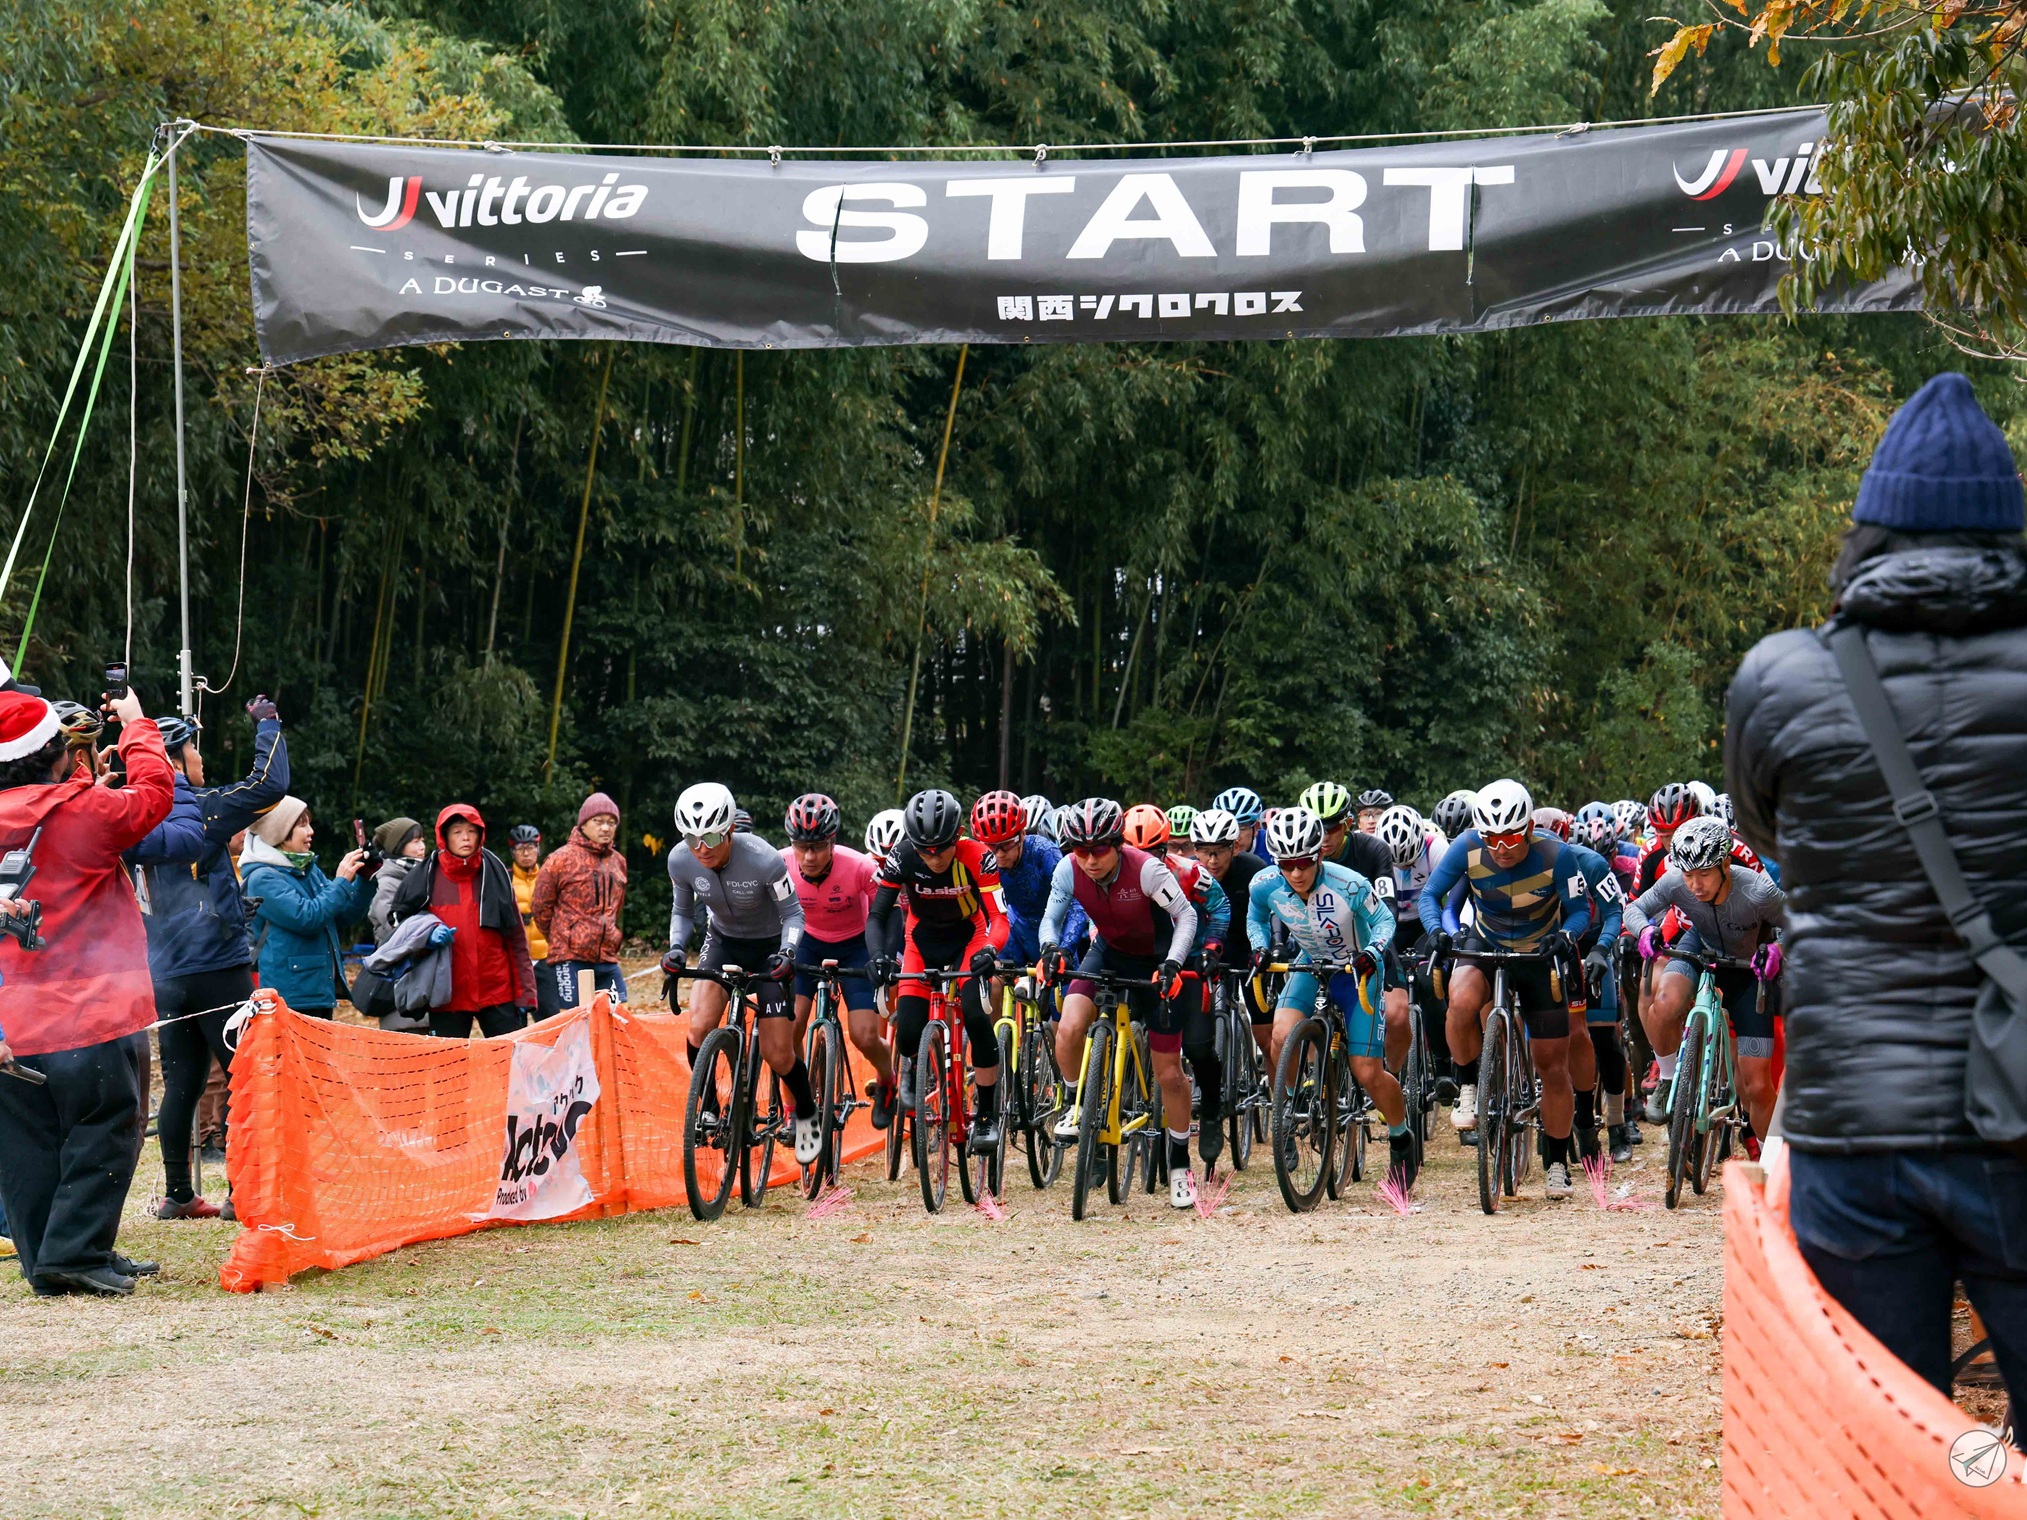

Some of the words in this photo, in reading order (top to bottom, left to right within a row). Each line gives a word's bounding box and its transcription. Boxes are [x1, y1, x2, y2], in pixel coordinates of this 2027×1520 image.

[425, 172, 649, 228] vittoria
[797, 164, 1516, 263] START
[403, 249, 600, 266] SERIES
[399, 277, 422, 295] A
[433, 276, 569, 299] DUGAST
[996, 291, 1304, 321] 関西シクロクロス
[726, 879, 759, 888] FDI-CYC
[783, 878, 792, 895] 7
[1377, 880, 1388, 896] 8
[1577, 877, 1585, 894] 5
[1600, 877, 1617, 900] 18
[1161, 888, 1174, 903] 1
